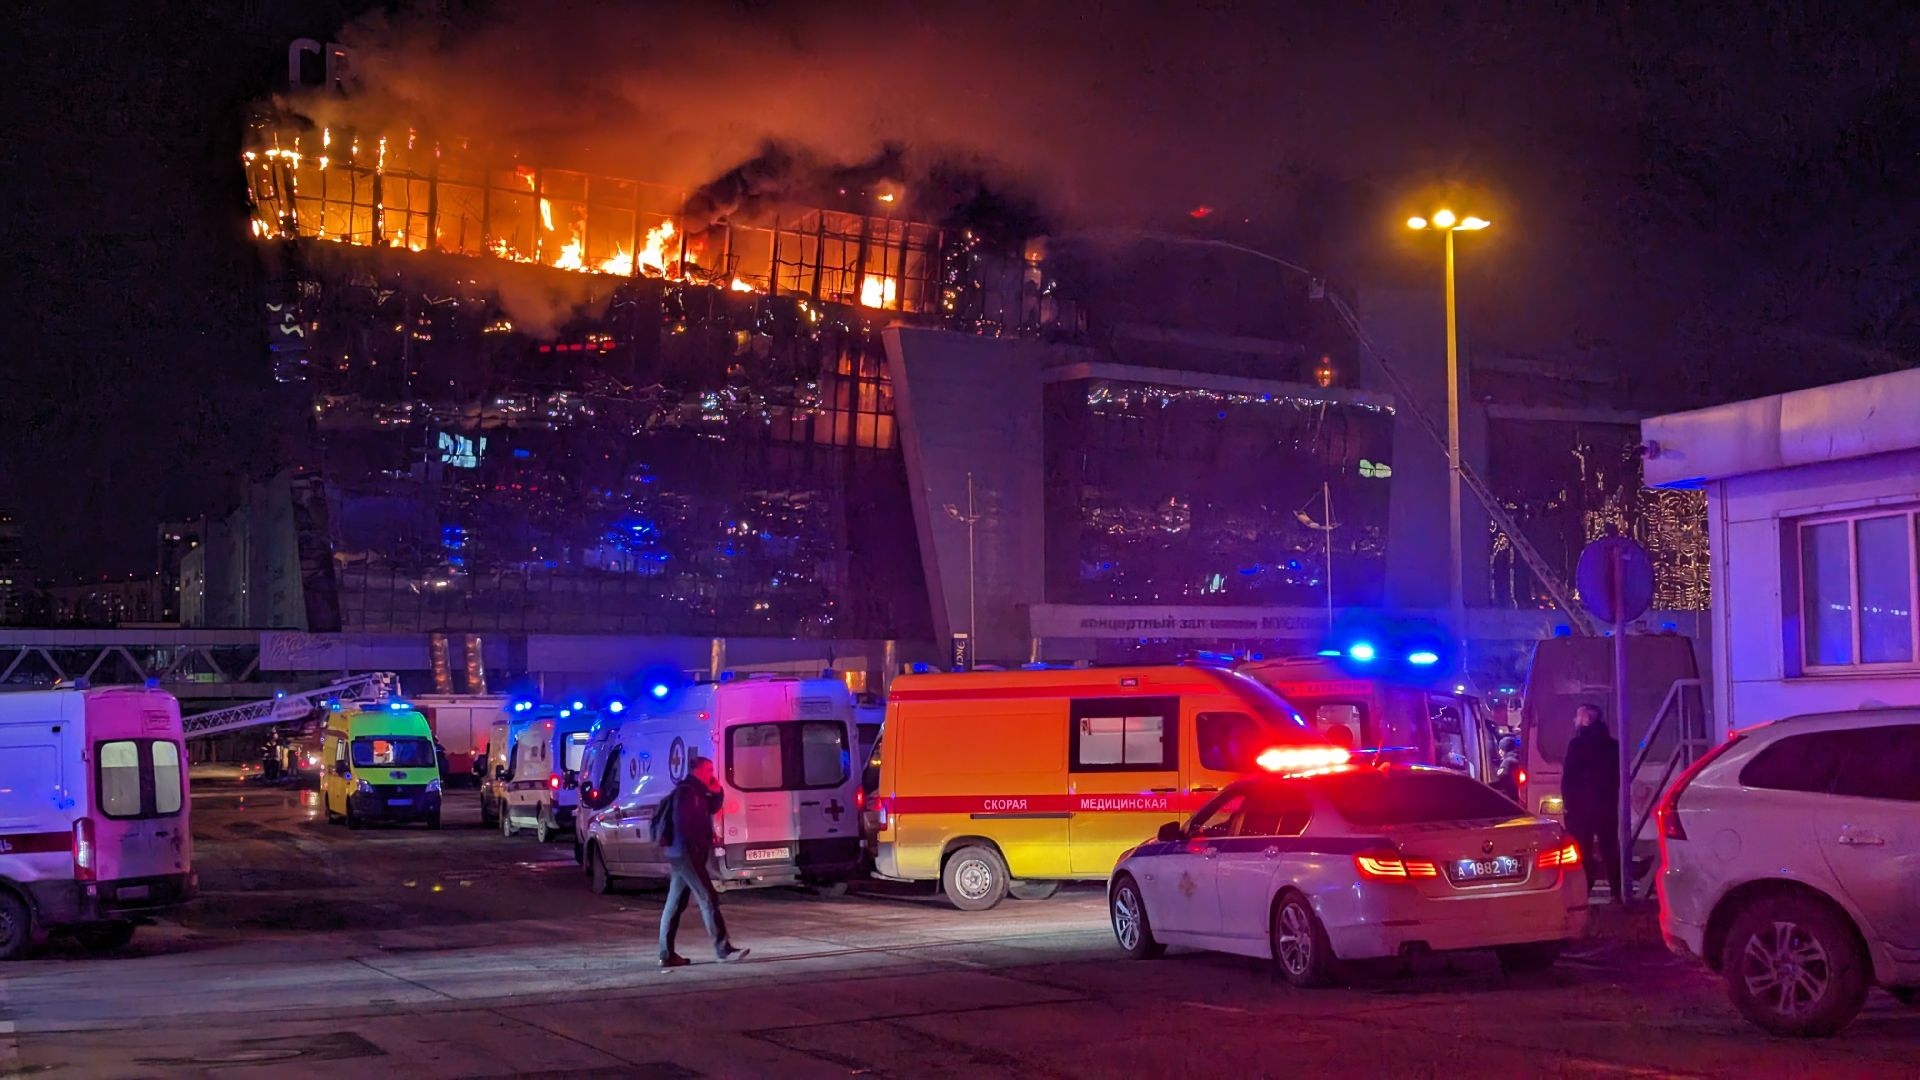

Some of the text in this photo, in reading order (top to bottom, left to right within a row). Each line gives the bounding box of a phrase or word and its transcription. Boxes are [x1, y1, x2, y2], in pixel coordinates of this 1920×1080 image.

[984, 798, 1167, 811] СКОРАЯ МЕДИЦИНСКАЯ
[1469, 860, 1500, 876] 1882
